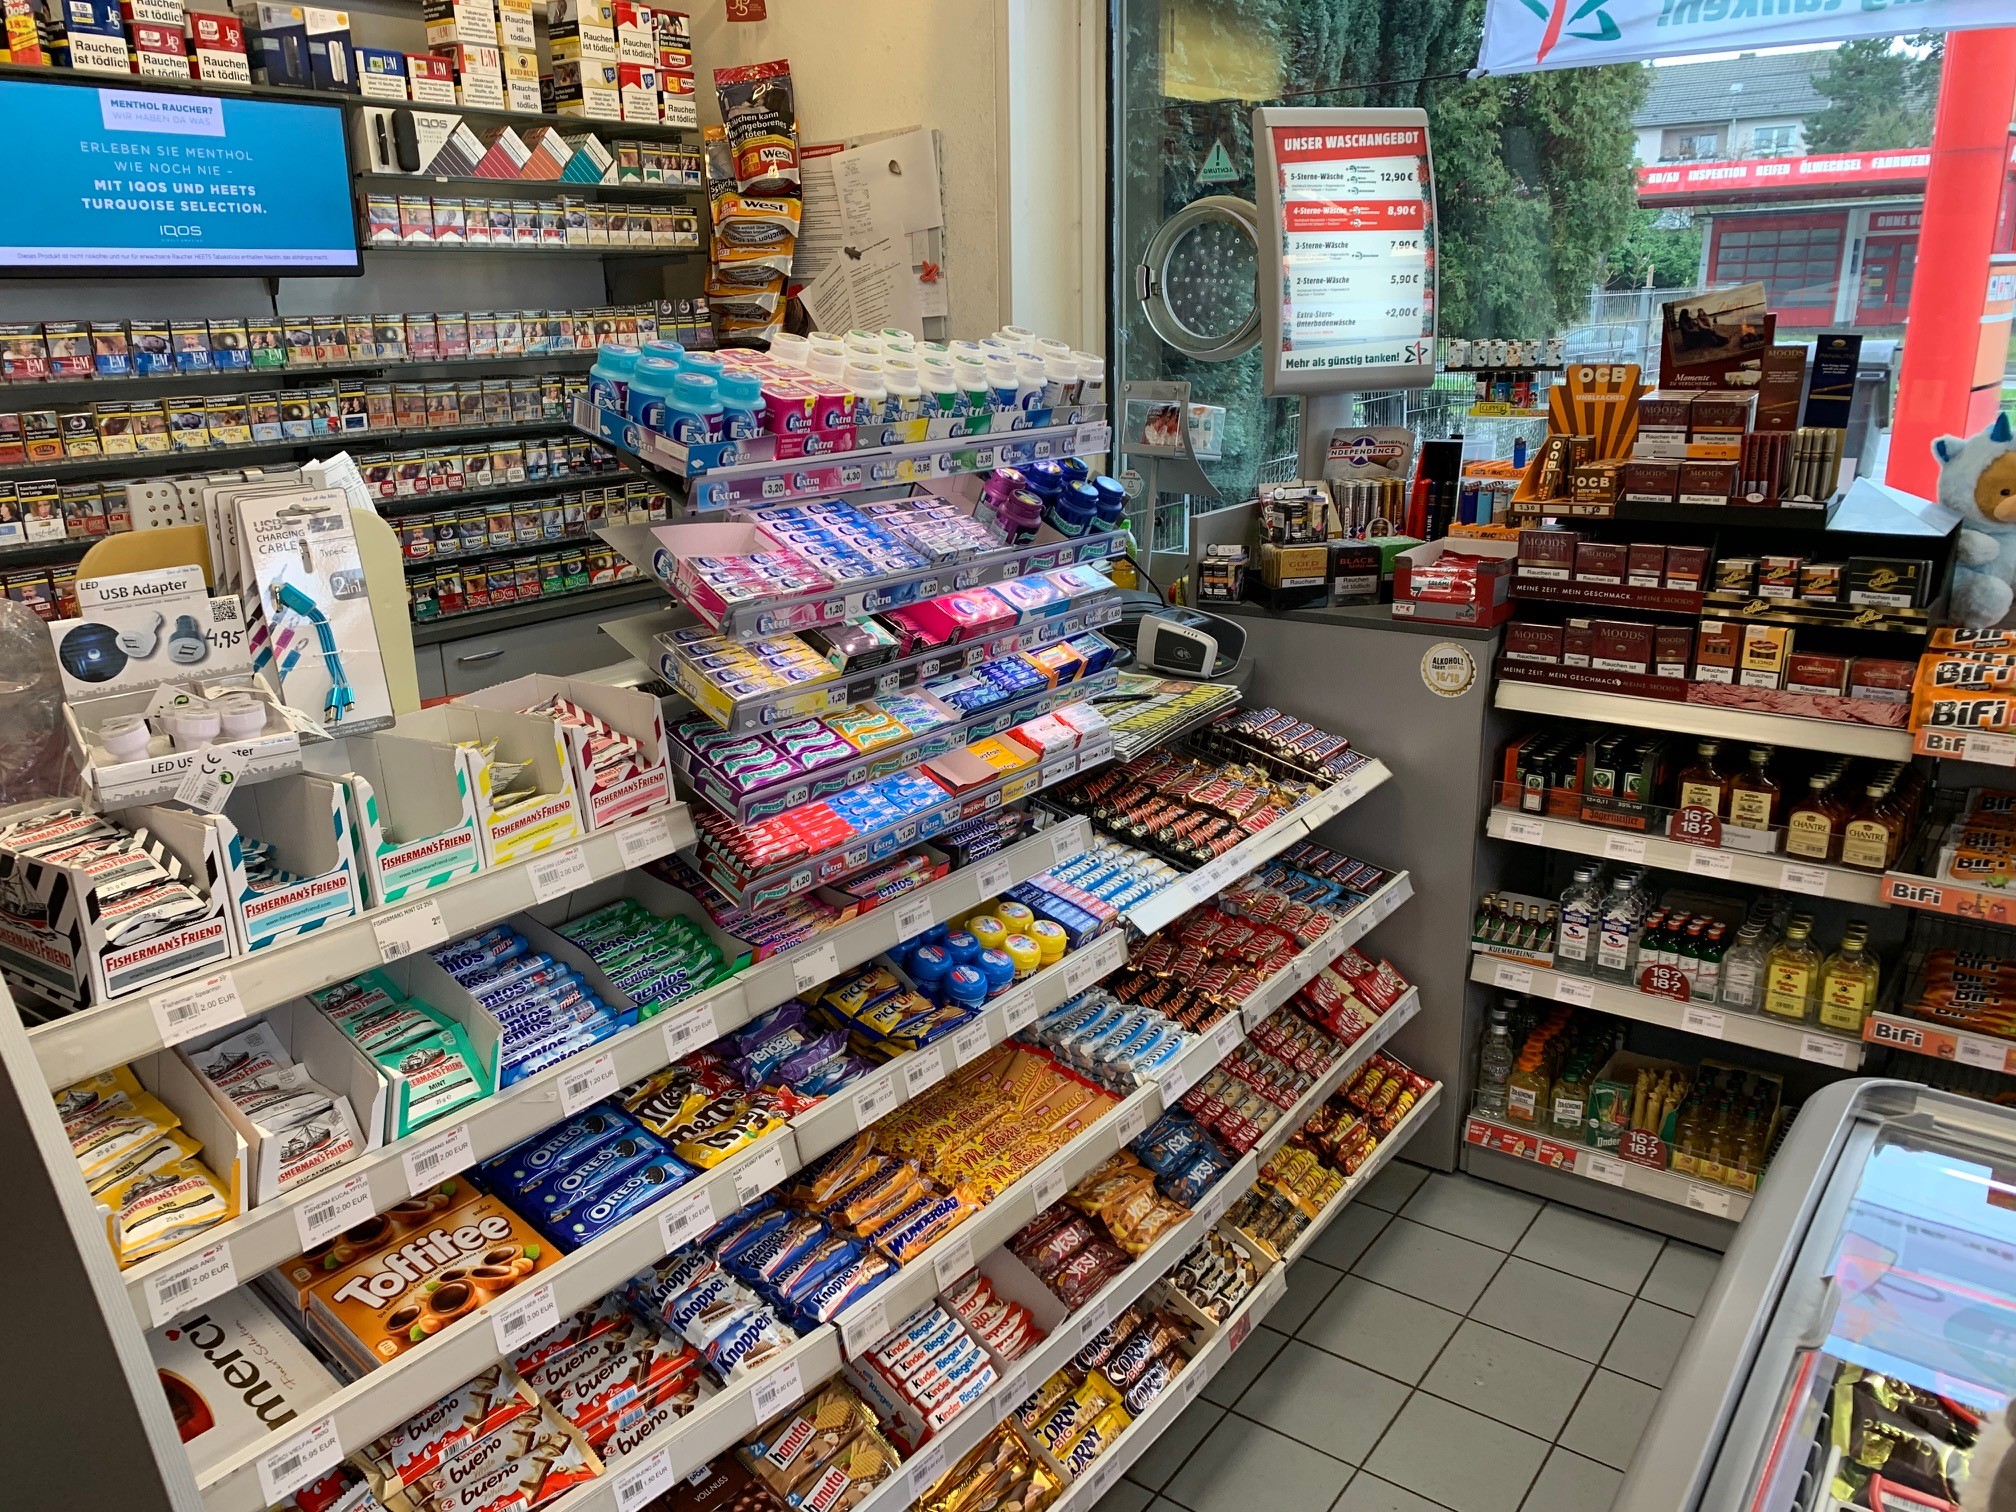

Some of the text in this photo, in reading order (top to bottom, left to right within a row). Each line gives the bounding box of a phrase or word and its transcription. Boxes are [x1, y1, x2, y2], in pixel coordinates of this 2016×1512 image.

[505, 15, 533, 26] Rauchen
[510, 33, 532, 44] tödlich
[583, 32, 614, 43] Rauchen
[623, 37, 652, 49] Rauchen
[75, 40, 125, 55] Rauchen
[592, 43, 616, 54] tödlich
[632, 48, 654, 59] tödlich
[92, 55, 129, 68] tödlich
[143, 54, 187, 68] Rauchen
[203, 56, 247, 69] Rauchen
[670, 55, 685, 64] West
[218, 70, 250, 82] tödlich
[110, 99, 213, 115] MENTHOL RAUCHER?
[668, 104, 696, 114] Rauchen
[112, 112, 133, 120] WIR
[135, 114, 170, 123] HABEN
[173, 115, 187, 124] DA
[416, 117, 449, 129] IQOS
[676, 114, 698, 124] tödlich
[758, 111, 779, 120] kann
[745, 129, 767, 139] töten
[1284, 131, 1419, 151] UNSER WASCHANGEBOT
[80, 141, 254, 161] ERLEBEN SIE MENTHOL
[762, 148, 791, 160] West
[114, 161, 221, 176] WIE NOCH NIE
[1689, 167, 1747, 181] INSPEKTION
[1756, 163, 1791, 176] REIFEN
[1800, 159, 1862, 173] ÖLWECHSEL
[1290, 172, 1406, 183] 5-Sterne-Wäsche 12,90
[94, 179, 256, 196] MIT IQOS UND HEETS
[81, 198, 267, 214] TURQUOISE SELECTION.
[744, 200, 787, 212] West
[1293, 206, 1408, 216] 4-Sterne-Wäsche 8,90
[1878, 215, 1907, 227] OHNE
[160, 225, 202, 238] IQOS
[1295, 240, 1410, 250] 3-Sterne-Wäsche 7,90
[1297, 275, 1411, 285] 2-Sterne-Wäsche 5,90
[1297, 308, 1411, 328] Unterbodenwäsche +2,00
[1286, 352, 1400, 369] Mehr als günstig tanken!
[1768, 349, 1805, 358] MOODS
[1579, 367, 1628, 384] OCB
[1675, 373, 1711, 382] Momente
[722, 452, 750, 464] Extra
[1576, 477, 1610, 488] OCB
[712, 490, 740, 502] Extra
[253, 518, 283, 533] USB
[257, 529, 306, 543] CHARGING
[1525, 537, 1567, 549] MOODS
[259, 541, 298, 554] CABLE
[320, 545, 347, 557] Type-C
[1339, 557, 1375, 565] BLACK
[1290, 578, 1317, 586] Rauchen
[80, 580, 188, 601] LED USB Adapter
[1516, 584, 1634, 600] MEINE ZEIT. MEIN GESCHMACK.
[205, 628, 245, 649] 4,95
[1601, 628, 1645, 641] MOODS
[1432, 657, 1464, 666] ALKOHOL?
[1930, 699, 2003, 726] BiFi
[638, 772, 665, 790] FRIEND
[491, 800, 571, 839] FISHERMAN'S FRIEND
[1239, 806, 1279, 834] TWIX
[1682, 809, 1714, 823] 16?
[1681, 821, 1713, 836] 18?
[381, 832, 471, 871] FISHERMAN'S FRIEND
[245, 876, 347, 919] FISHERMAN'S FRIEND
[1892, 882, 1942, 905] BiFi
[373, 912, 403, 927] FISHERMANS
[105, 923, 223, 973] FISHERMAN'S FRIEND
[1488, 945, 1535, 959] KUEMMERLING
[217, 993, 236, 1007] EUR
[1105, 1012, 1144, 1047] BOUNTY
[1874, 1022, 1923, 1047] BiFi
[748, 1036, 794, 1064] Tender
[529, 1124, 583, 1167] OREO
[157, 1200, 177, 1211] ANIS
[352, 1193, 369, 1207] EUR
[588, 1176, 643, 1221] OREO
[1049, 1230, 1082, 1256] YES!
[210, 1262, 230, 1277] EUR
[333, 1216, 513, 1310] Toffifee
[155, 1255, 216, 1289] FISHERMANS ANIS
[813, 1263, 861, 1309] Knoppers
[540, 1302, 554, 1314] EUR
[884, 1319, 941, 1360] kinder Riegel
[1106, 1330, 1151, 1386] CORNY
[180, 1313, 298, 1432] merci
[936, 1379, 990, 1426] kinder Riegel
[407, 1398, 460, 1441] bueno
[617, 1409, 668, 1455] bueno
[1054, 1427, 1073, 1450] BIG
[318, 1436, 336, 1452] EUR
[769, 1420, 811, 1466] hanuta
[449, 1438, 502, 1484] bueno
